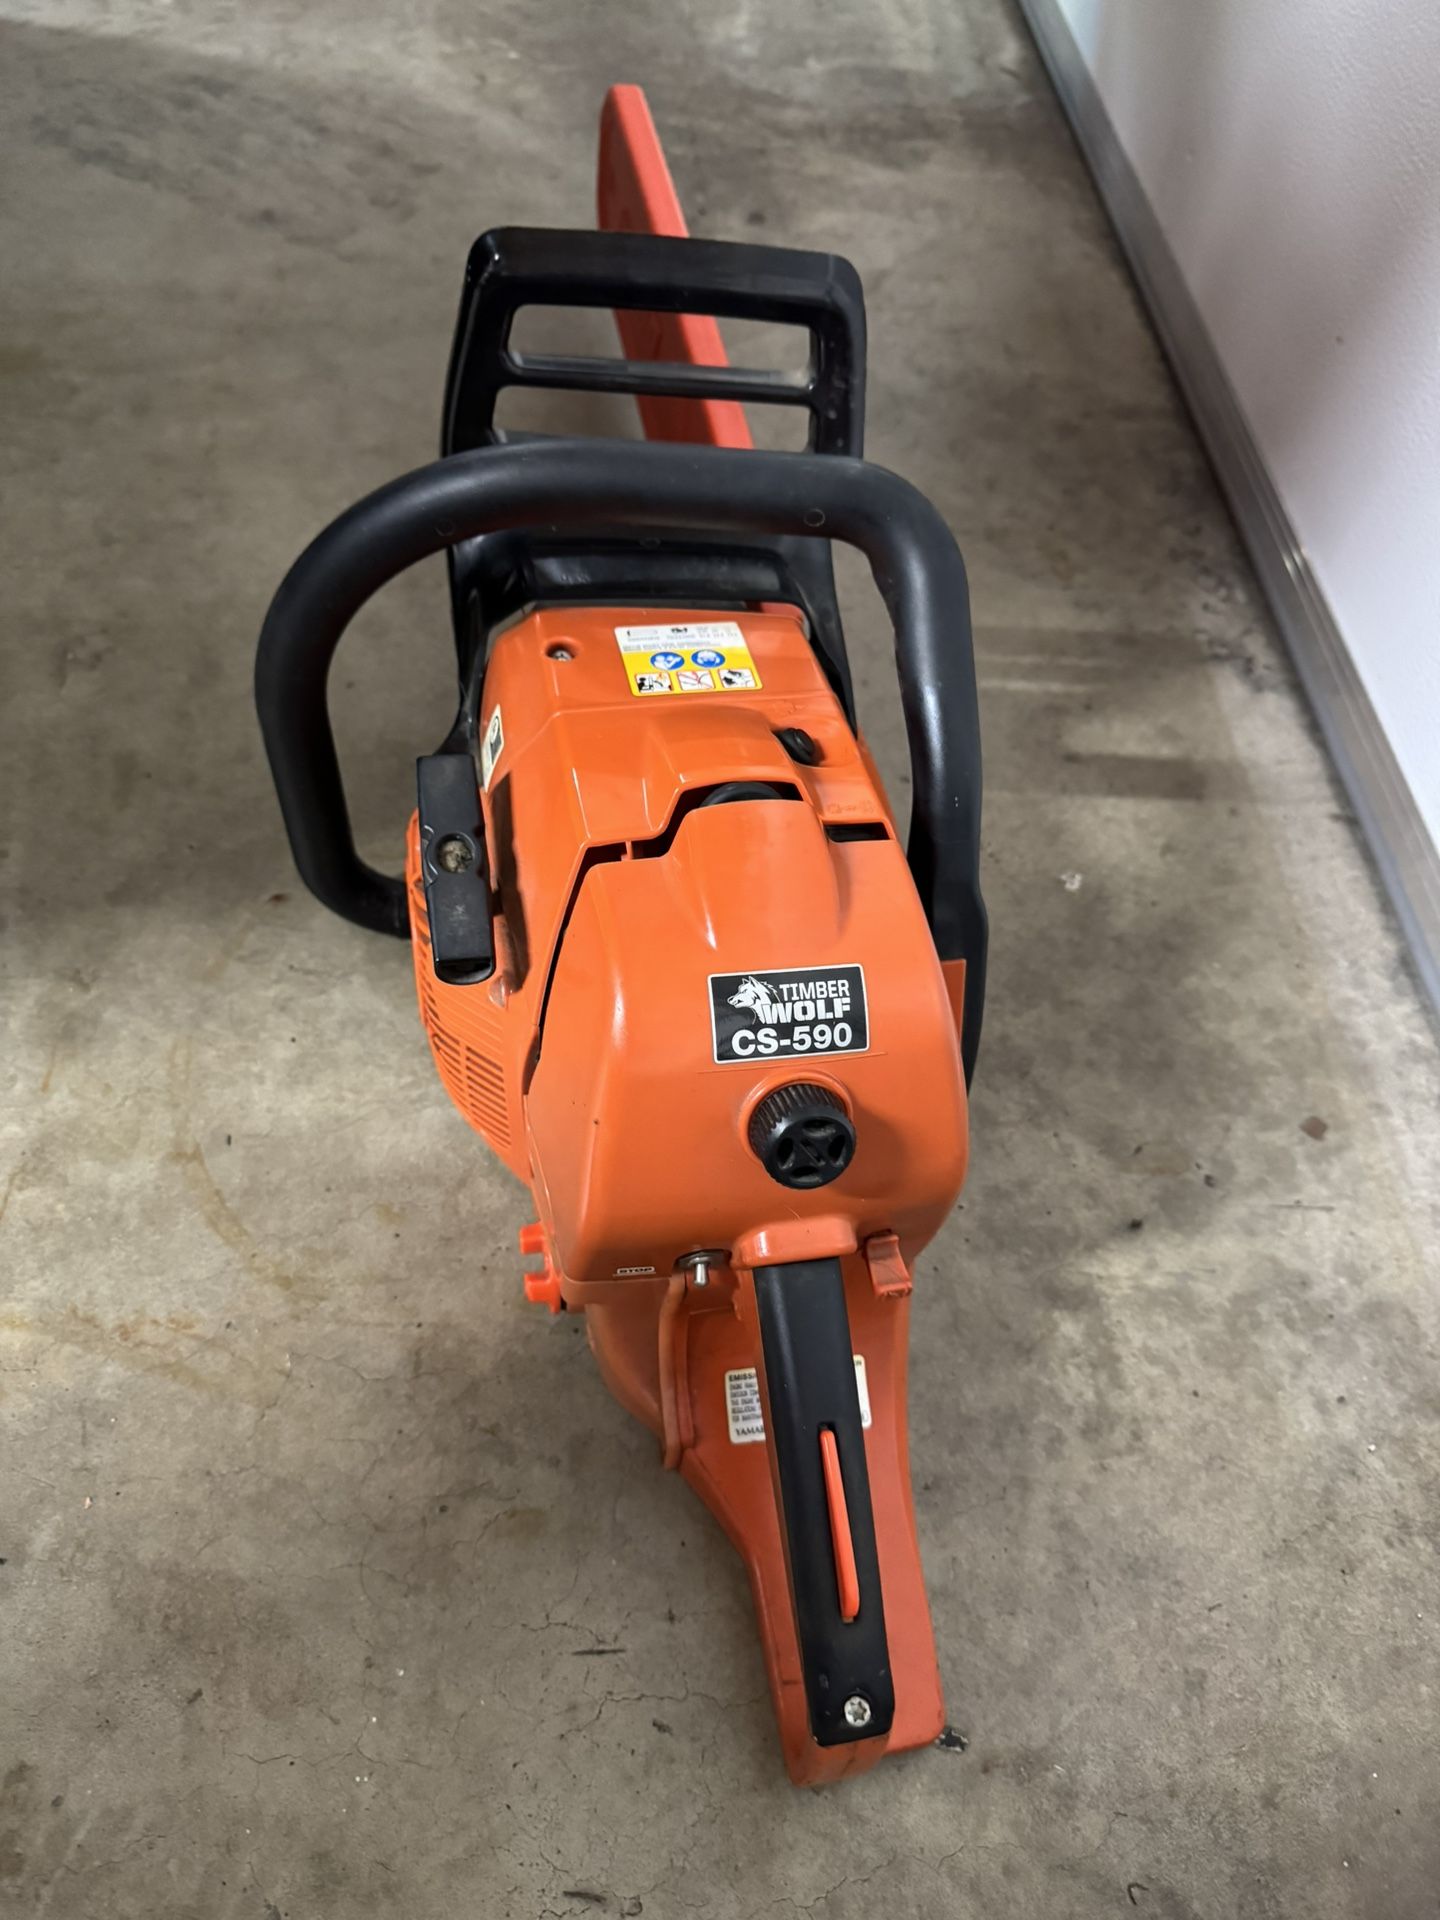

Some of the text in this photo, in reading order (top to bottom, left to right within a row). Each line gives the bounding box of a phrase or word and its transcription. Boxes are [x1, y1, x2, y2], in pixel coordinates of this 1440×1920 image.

[779, 980, 850, 1001] TIMBER
[761, 997, 851, 1025] WOLF
[731, 1022, 852, 1056] CS-590
[729, 1372, 756, 1382] EMISS
